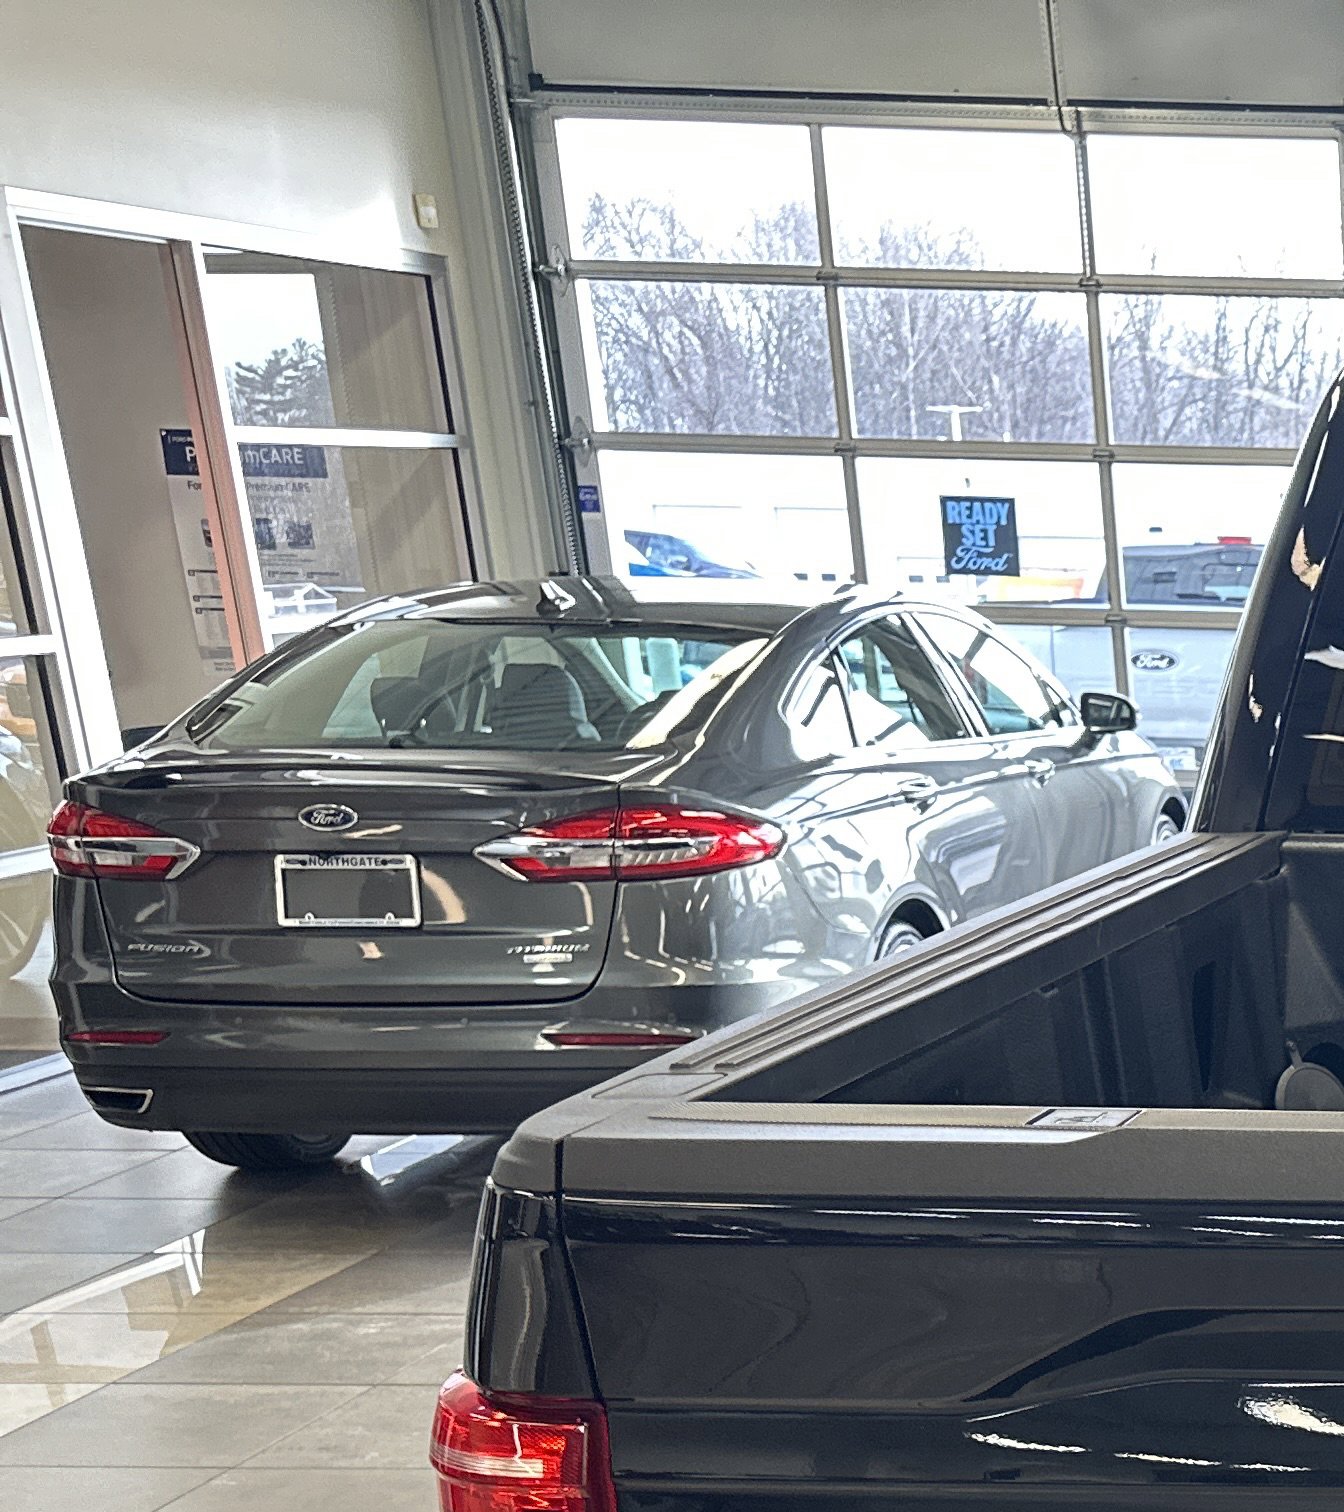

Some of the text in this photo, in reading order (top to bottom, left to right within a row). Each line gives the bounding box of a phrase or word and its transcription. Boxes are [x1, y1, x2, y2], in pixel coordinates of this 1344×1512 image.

[946, 501, 1009, 525] READY
[961, 524, 997, 547] SET
[951, 546, 1009, 571] Ford
[310, 809, 344, 825] Ford
[309, 856, 380, 867] NORTHGATE
